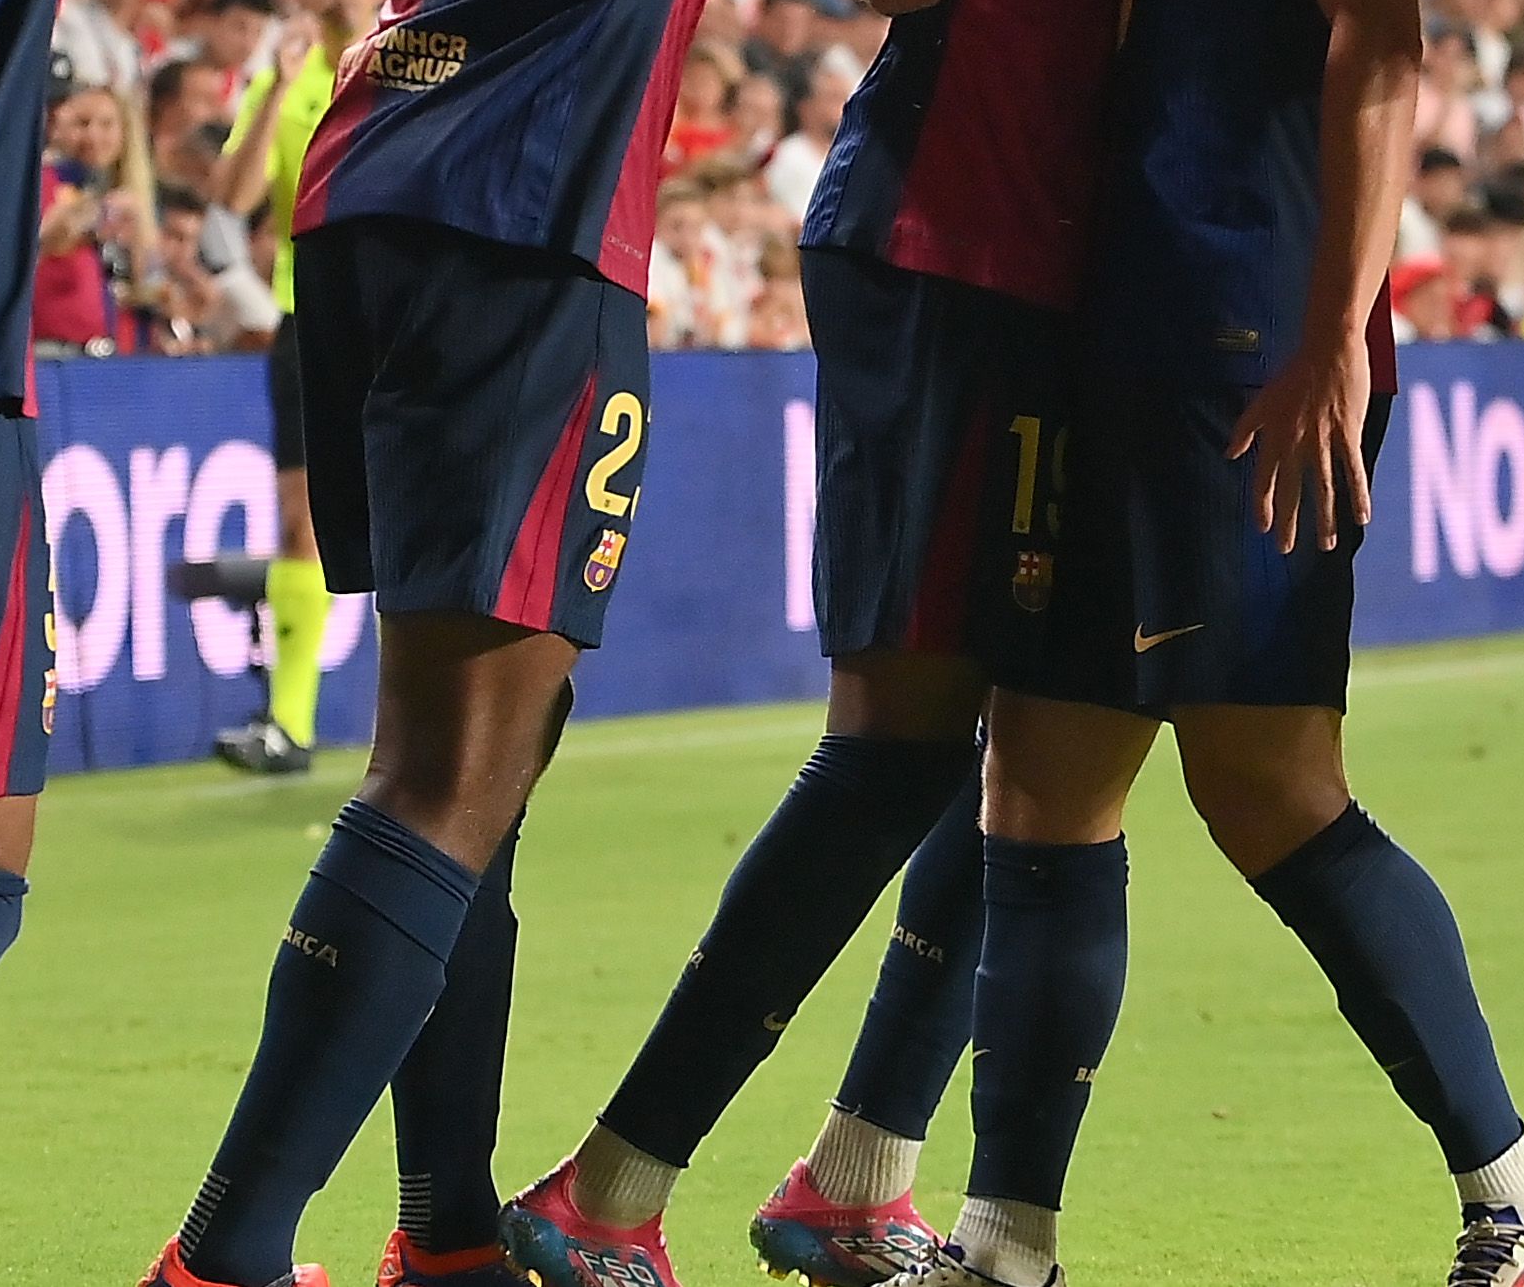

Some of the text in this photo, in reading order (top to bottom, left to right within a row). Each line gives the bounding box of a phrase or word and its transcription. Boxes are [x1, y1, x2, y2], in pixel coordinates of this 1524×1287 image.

[585, 391, 652, 522] 2
[281, 924, 338, 968] ARÇA
[892, 925, 944, 964] ARÇA
